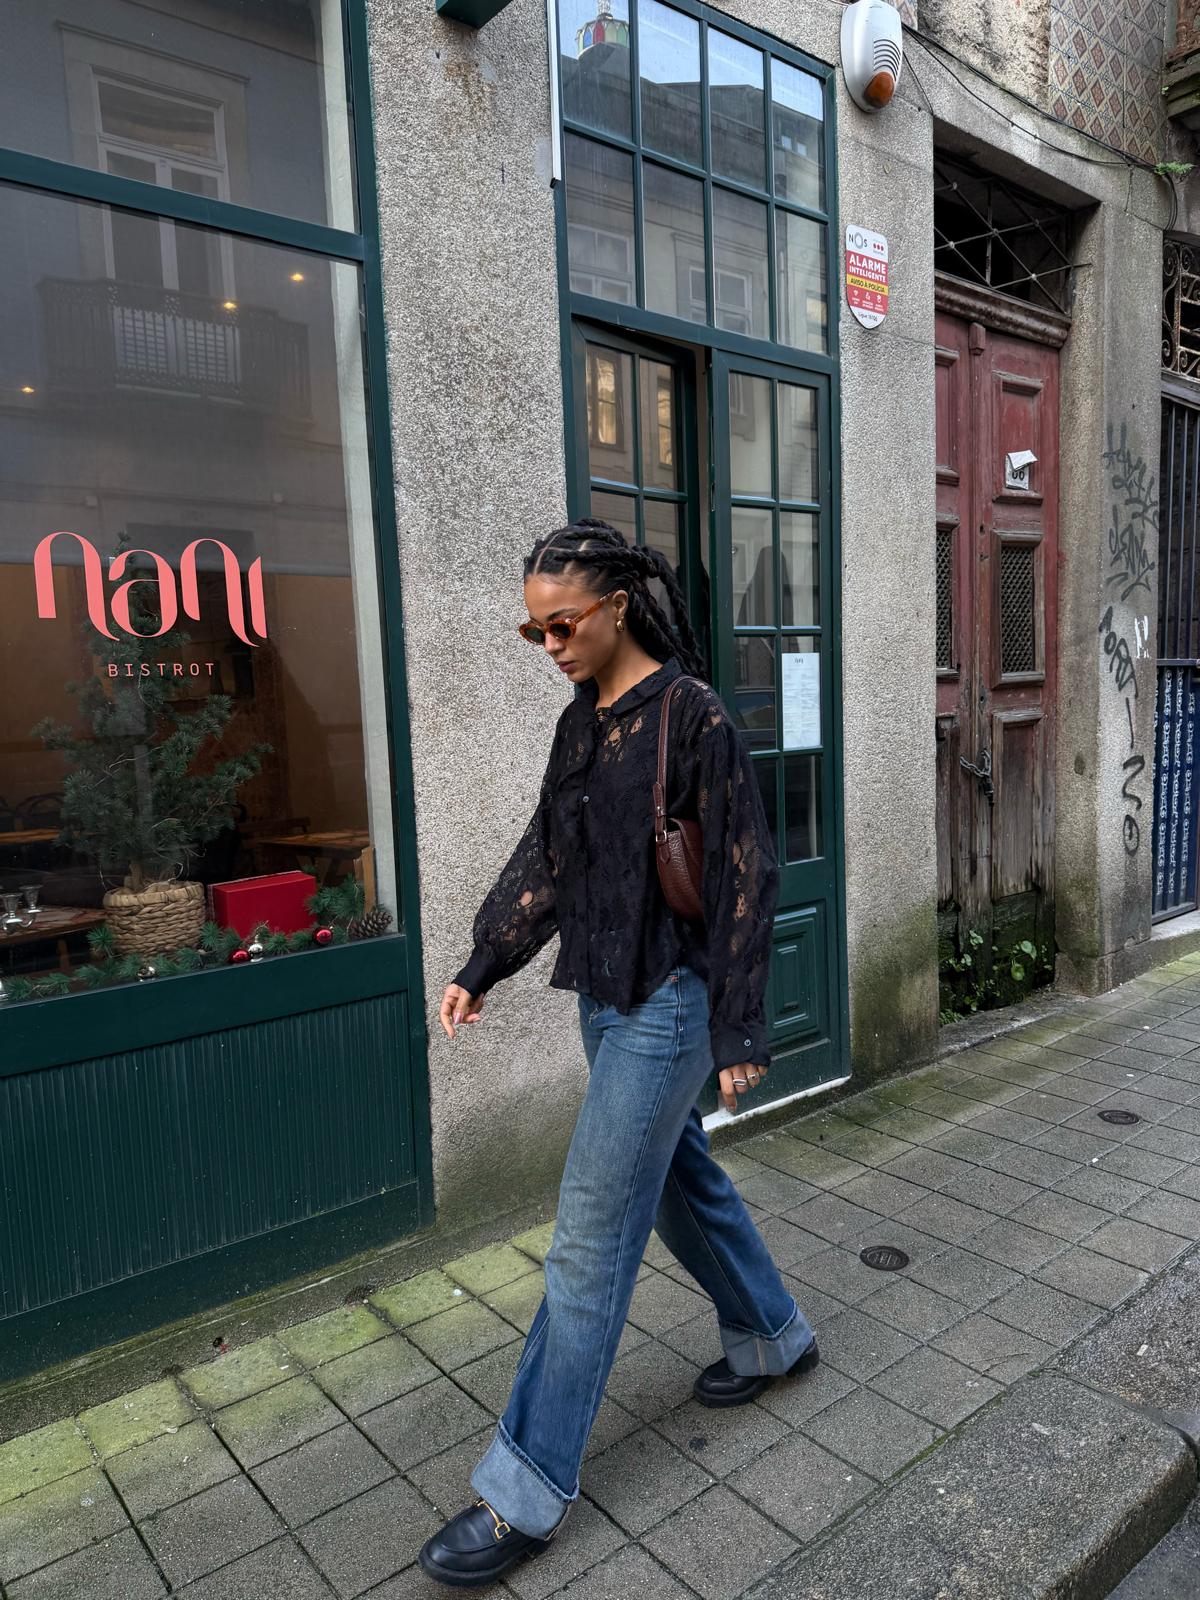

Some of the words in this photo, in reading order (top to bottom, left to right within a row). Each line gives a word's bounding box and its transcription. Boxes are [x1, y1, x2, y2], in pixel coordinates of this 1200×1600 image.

[848, 232, 868, 249] NOS
[849, 254, 886, 274] ALARME
[849, 265, 887, 283] INTELIGENTE
[108, 662, 215, 678] BISTROT
